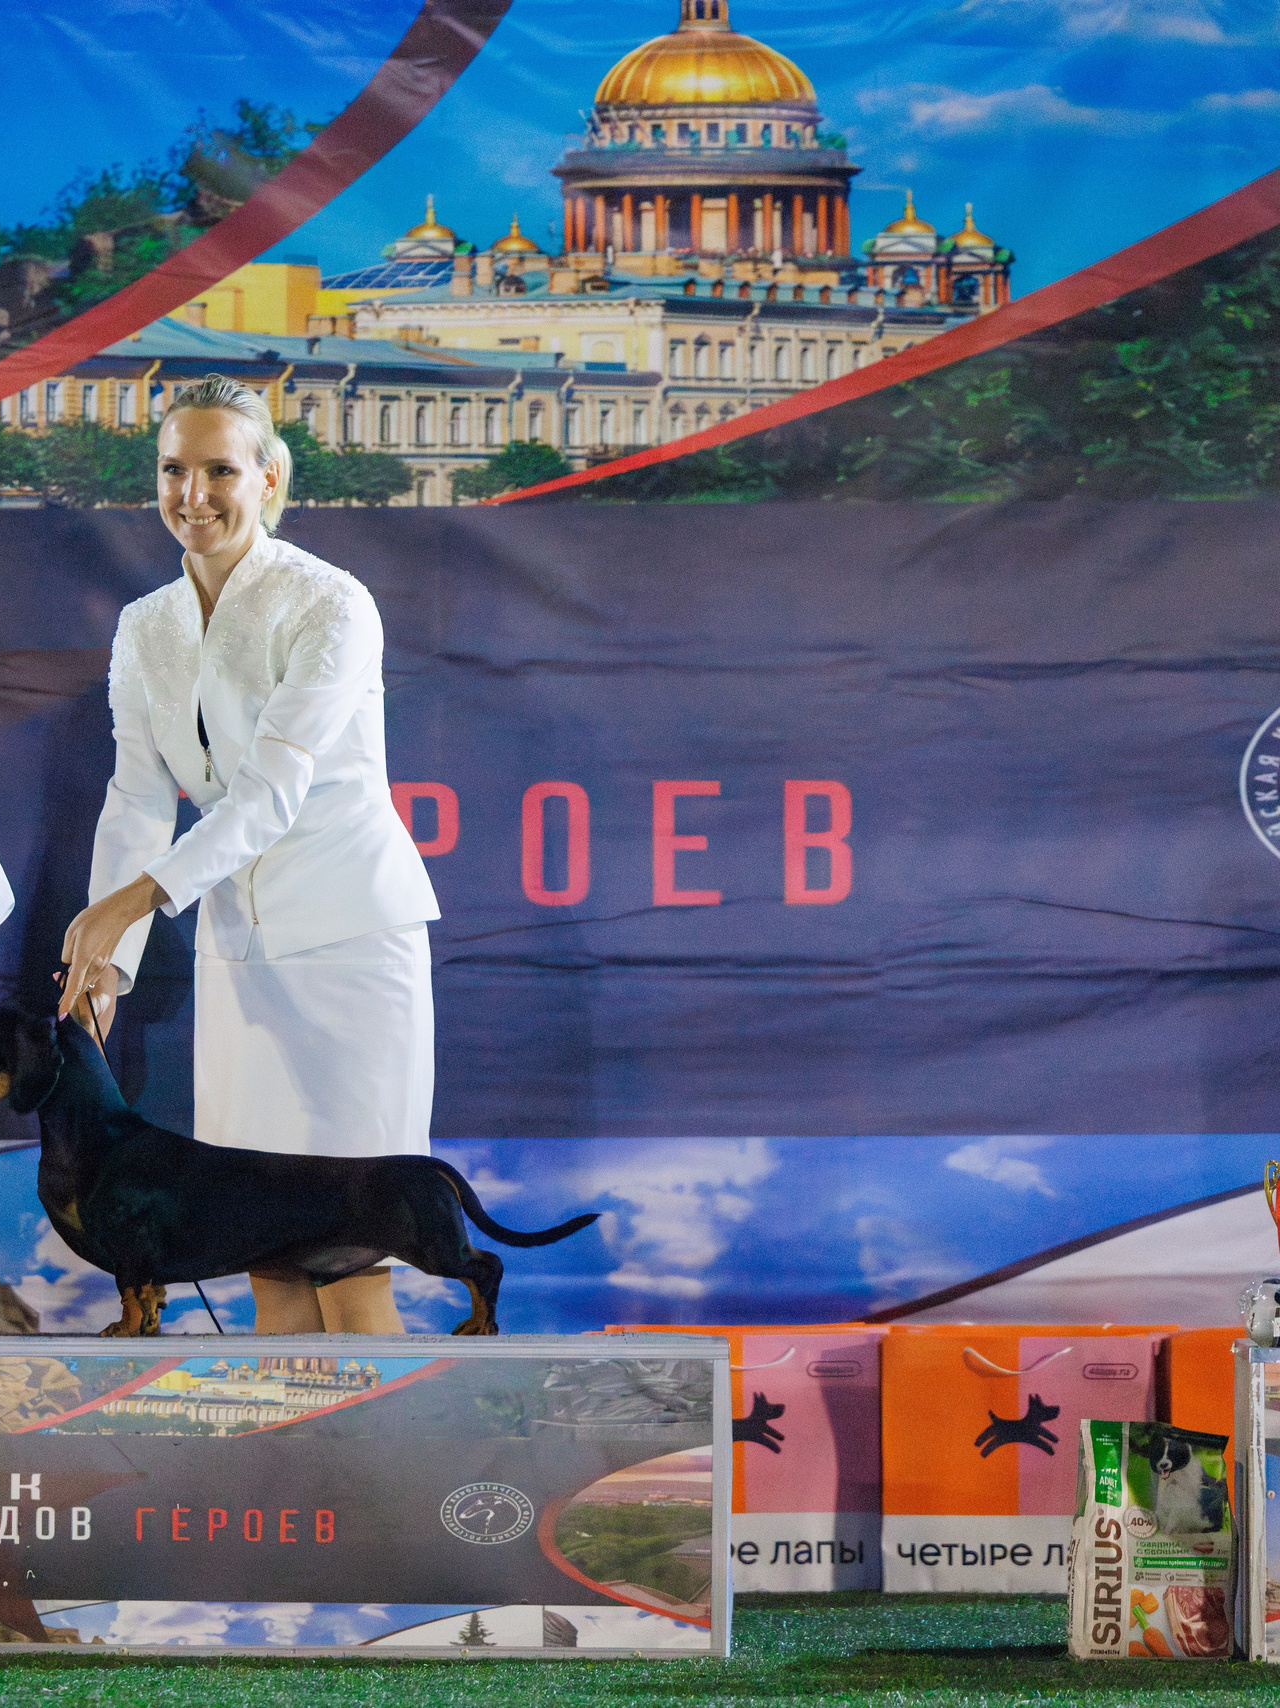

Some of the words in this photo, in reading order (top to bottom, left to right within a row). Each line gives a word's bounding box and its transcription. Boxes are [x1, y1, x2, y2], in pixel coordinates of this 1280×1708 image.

[390, 780, 853, 906] РОЕВ
[135, 1507, 335, 1543] ГЕРОЕВ
[1130, 1517, 1152, 1527] 40%
[770, 1540, 865, 1566] лапы
[897, 1542, 1033, 1567] четыре
[1091, 1516, 1123, 1646] SIRIUS
